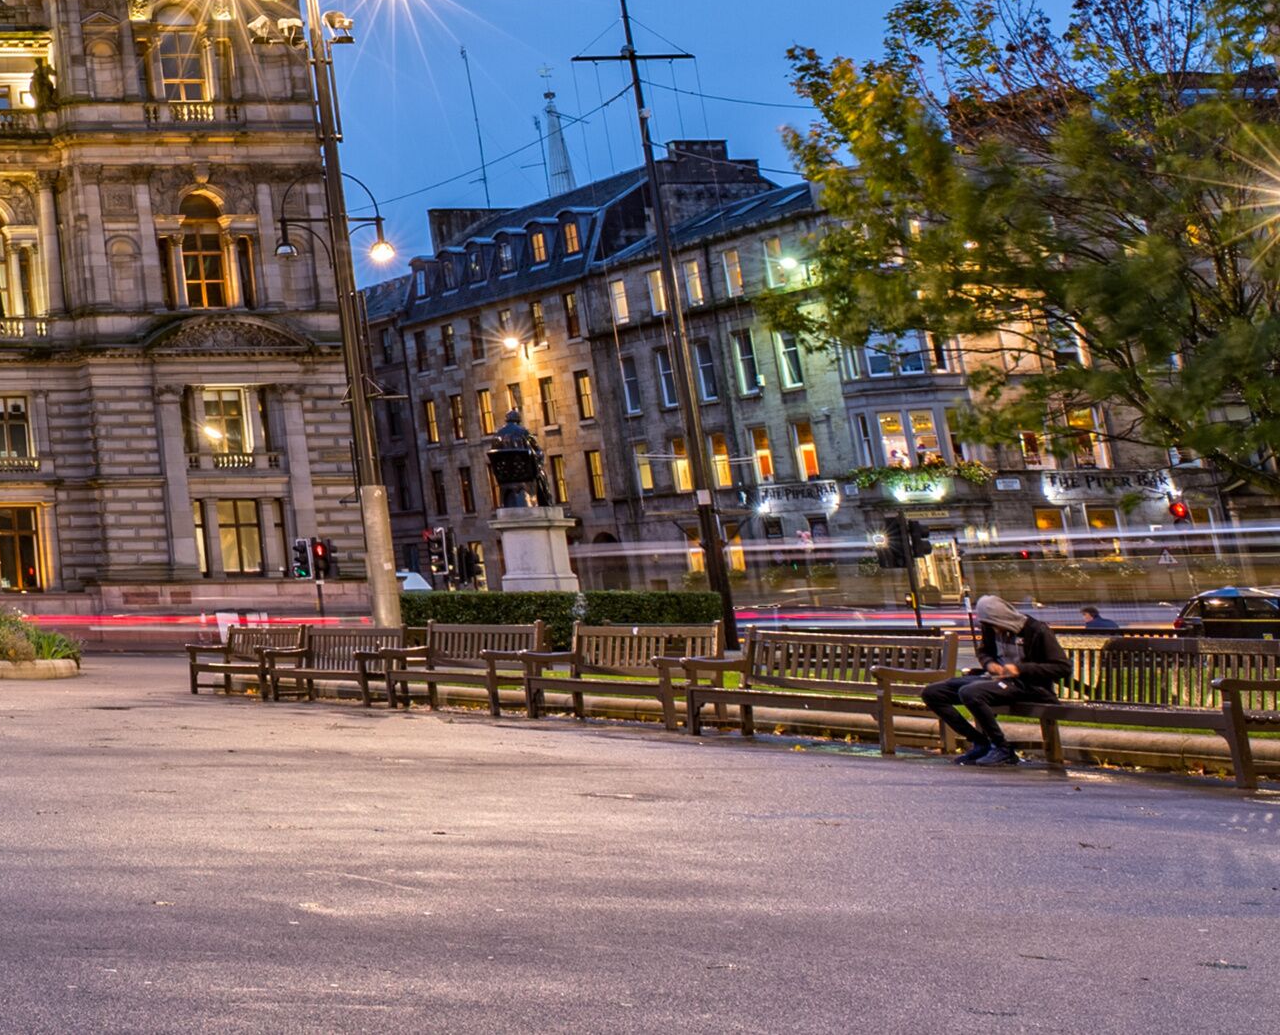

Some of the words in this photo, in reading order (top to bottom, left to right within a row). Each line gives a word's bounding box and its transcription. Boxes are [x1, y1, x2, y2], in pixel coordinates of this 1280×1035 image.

[1045, 473, 1080, 488] THE
[1085, 474, 1133, 489] PIPER
[784, 487, 814, 501] PIPER
